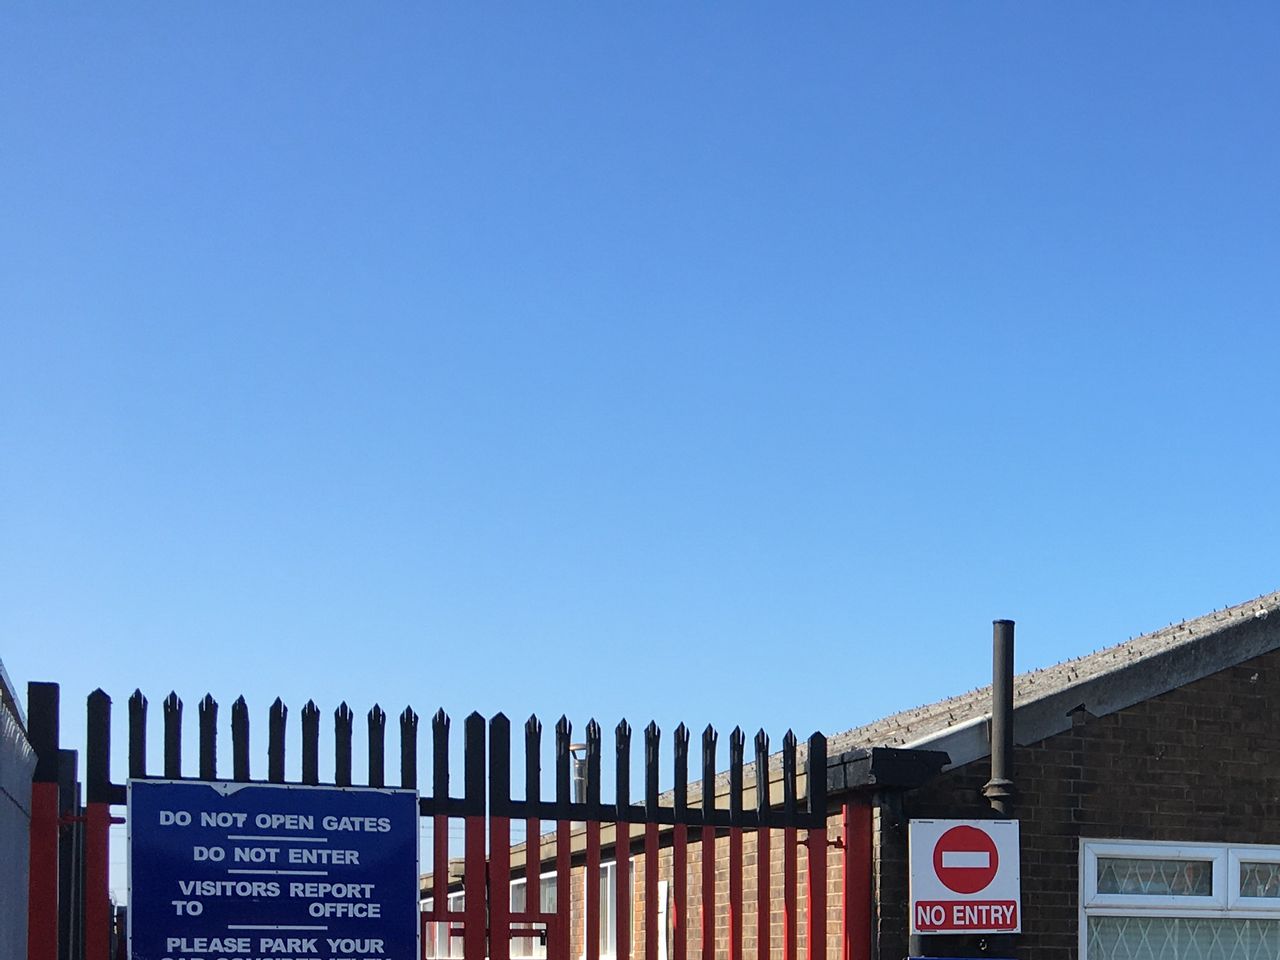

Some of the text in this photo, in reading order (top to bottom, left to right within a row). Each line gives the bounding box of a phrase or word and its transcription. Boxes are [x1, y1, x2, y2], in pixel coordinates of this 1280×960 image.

[159, 811, 391, 833] DO NOT OPEN GATES
[193, 847, 360, 865] DO NOT ENTER
[179, 880, 375, 899] VISITORS REPORT
[172, 901, 381, 918] TO OFFICE
[917, 905, 1015, 925] NO ENTRY
[166, 937, 385, 953] PLEASE PARK YOUR
